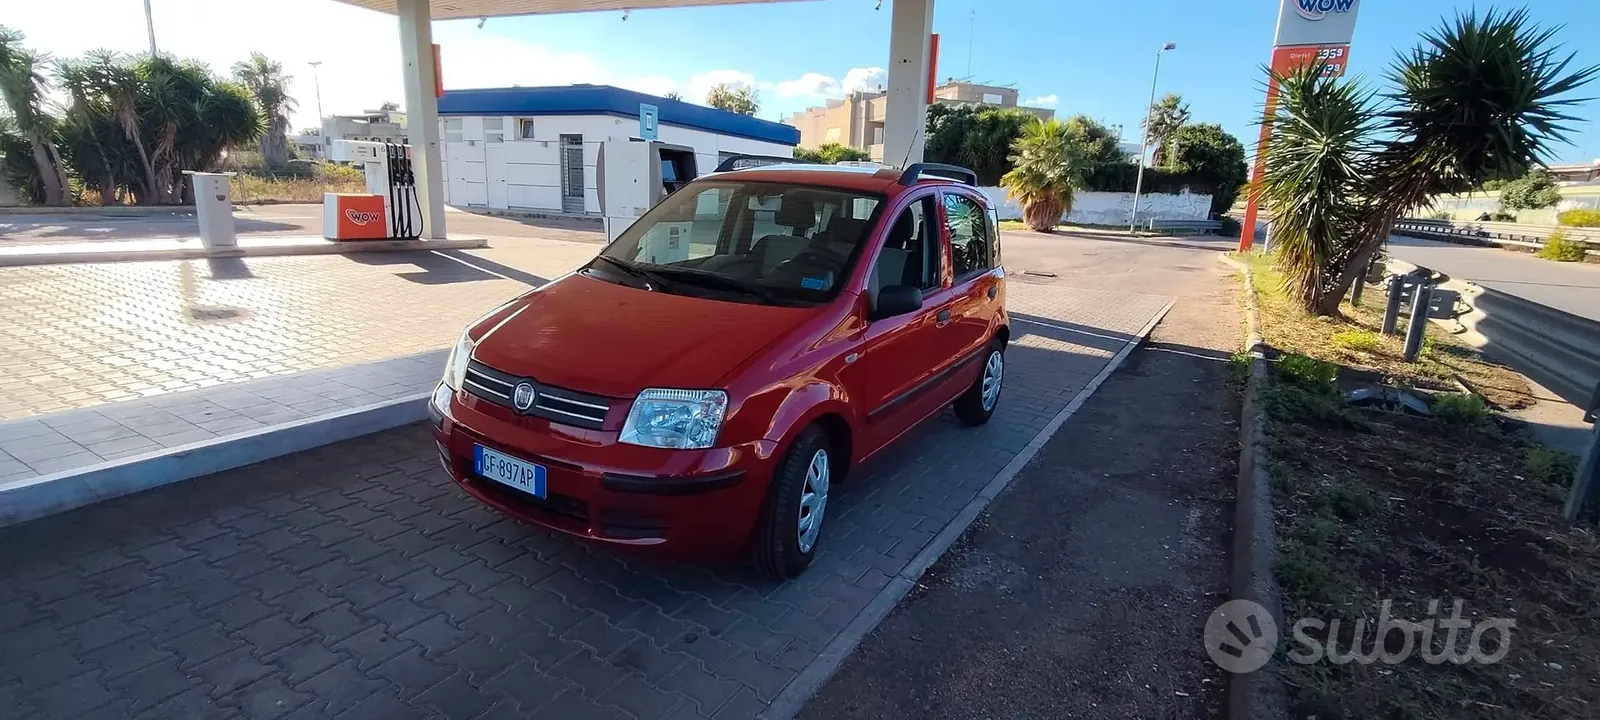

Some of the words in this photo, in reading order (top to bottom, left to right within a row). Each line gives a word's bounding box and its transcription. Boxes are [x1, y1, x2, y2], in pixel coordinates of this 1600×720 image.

[1298, 0, 1355, 13] WOW
[381, 145, 386, 153] 6
[350, 211, 380, 223] WOW
